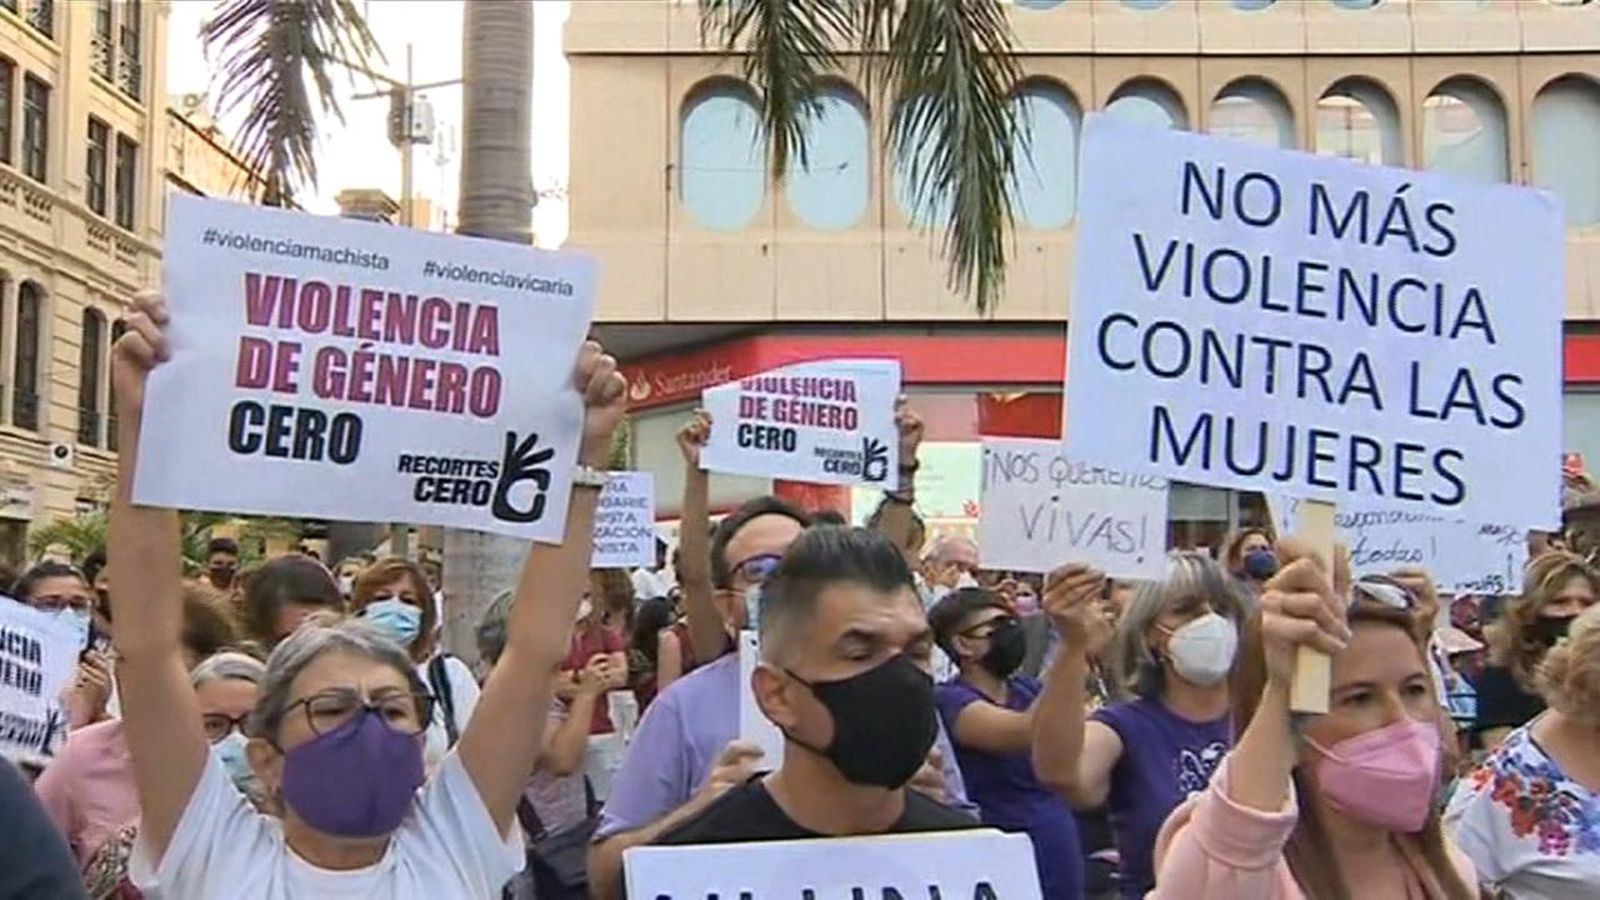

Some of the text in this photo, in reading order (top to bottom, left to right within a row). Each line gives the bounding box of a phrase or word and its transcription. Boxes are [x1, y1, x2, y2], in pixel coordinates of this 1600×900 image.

[1181, 161, 1458, 257] NO MÁS
[202, 227, 574, 297] #violenciamachista #violenciavicaria
[1133, 233, 1496, 345] VIOLENCIA
[243, 271, 500, 357] VIOLENCIA
[235, 336, 502, 418] DE GÉNERO
[655, 363, 731, 394] Santander
[1098, 312, 1526, 430] CONTRA LAS
[228, 400, 364, 465] CERO
[737, 424, 797, 452] CERO
[738, 396, 768, 420] DE
[398, 453, 499, 480] RECORTES
[823, 459, 862, 476] CERO
[1149, 404, 1467, 506] MUJERES
[412, 478, 492, 506] CERO
